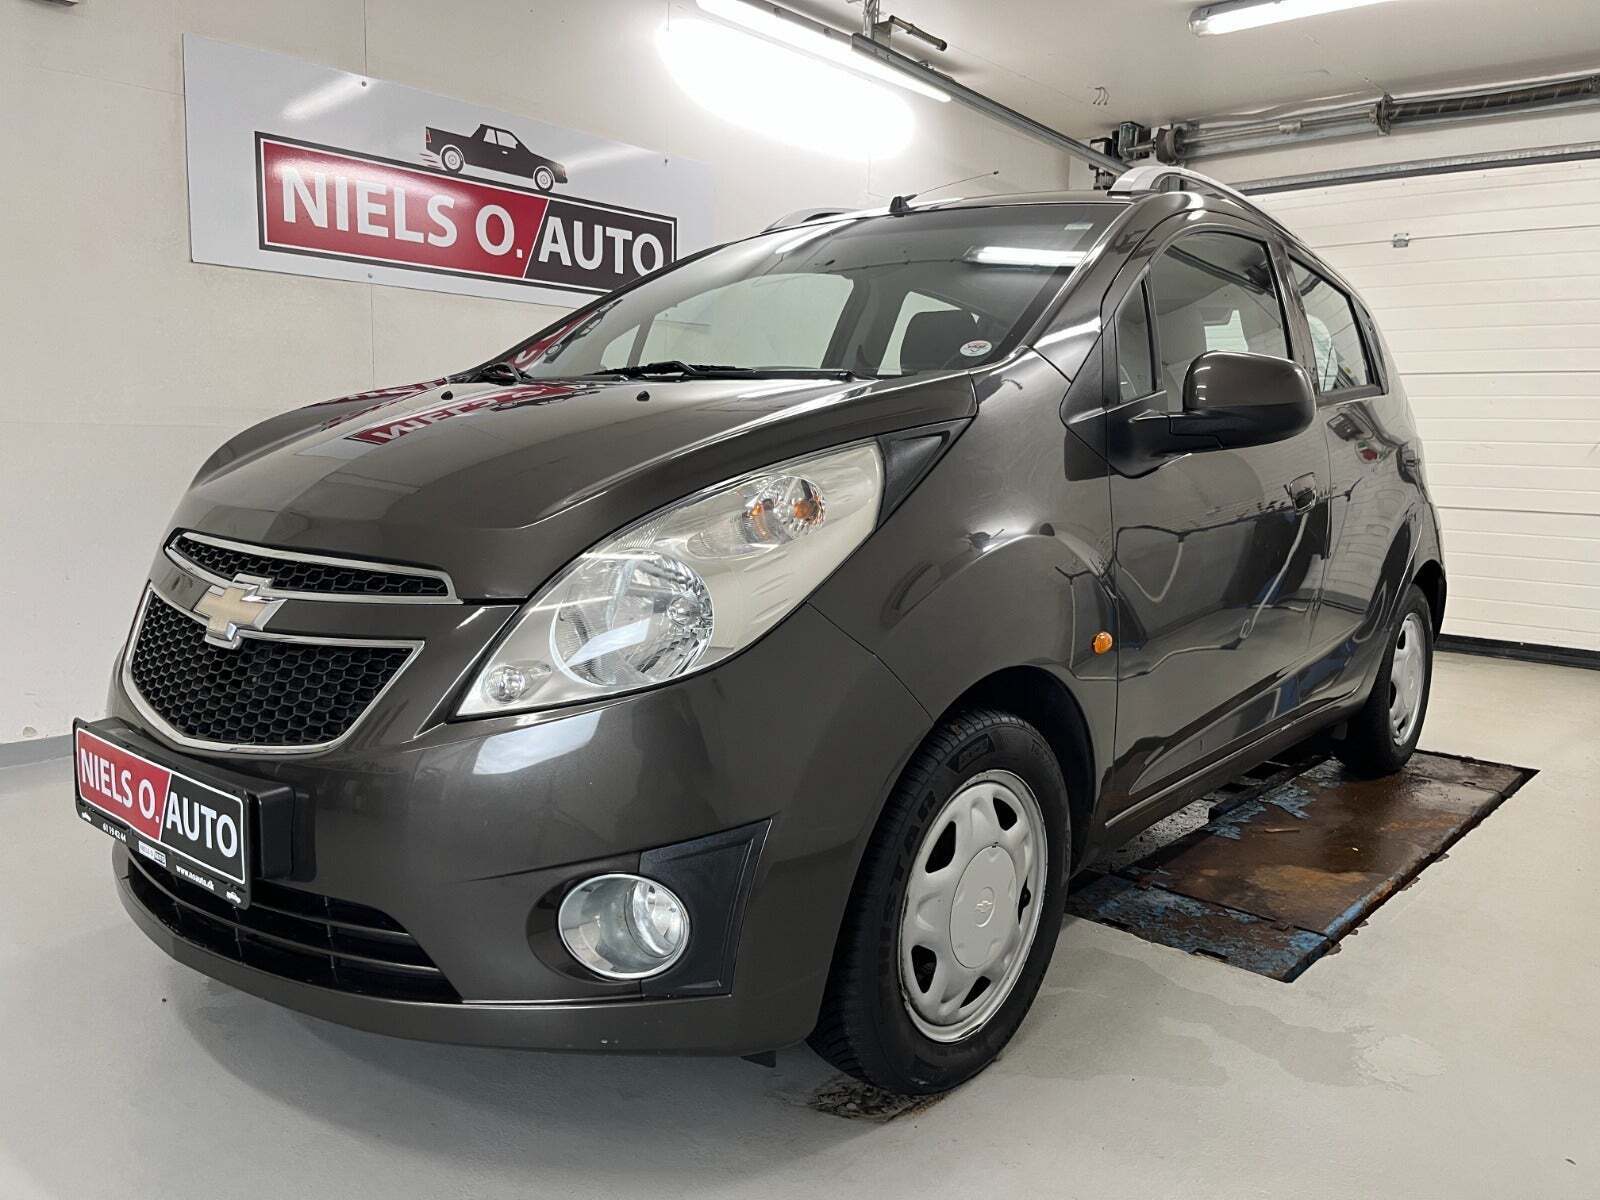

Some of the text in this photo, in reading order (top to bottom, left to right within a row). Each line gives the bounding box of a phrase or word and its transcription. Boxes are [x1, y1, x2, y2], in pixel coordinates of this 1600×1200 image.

[283, 166, 664, 276] NIELS O. AUTO
[80, 748, 133, 808] NIELS
[138, 779, 160, 823] O.
[166, 791, 238, 858] AUTO
